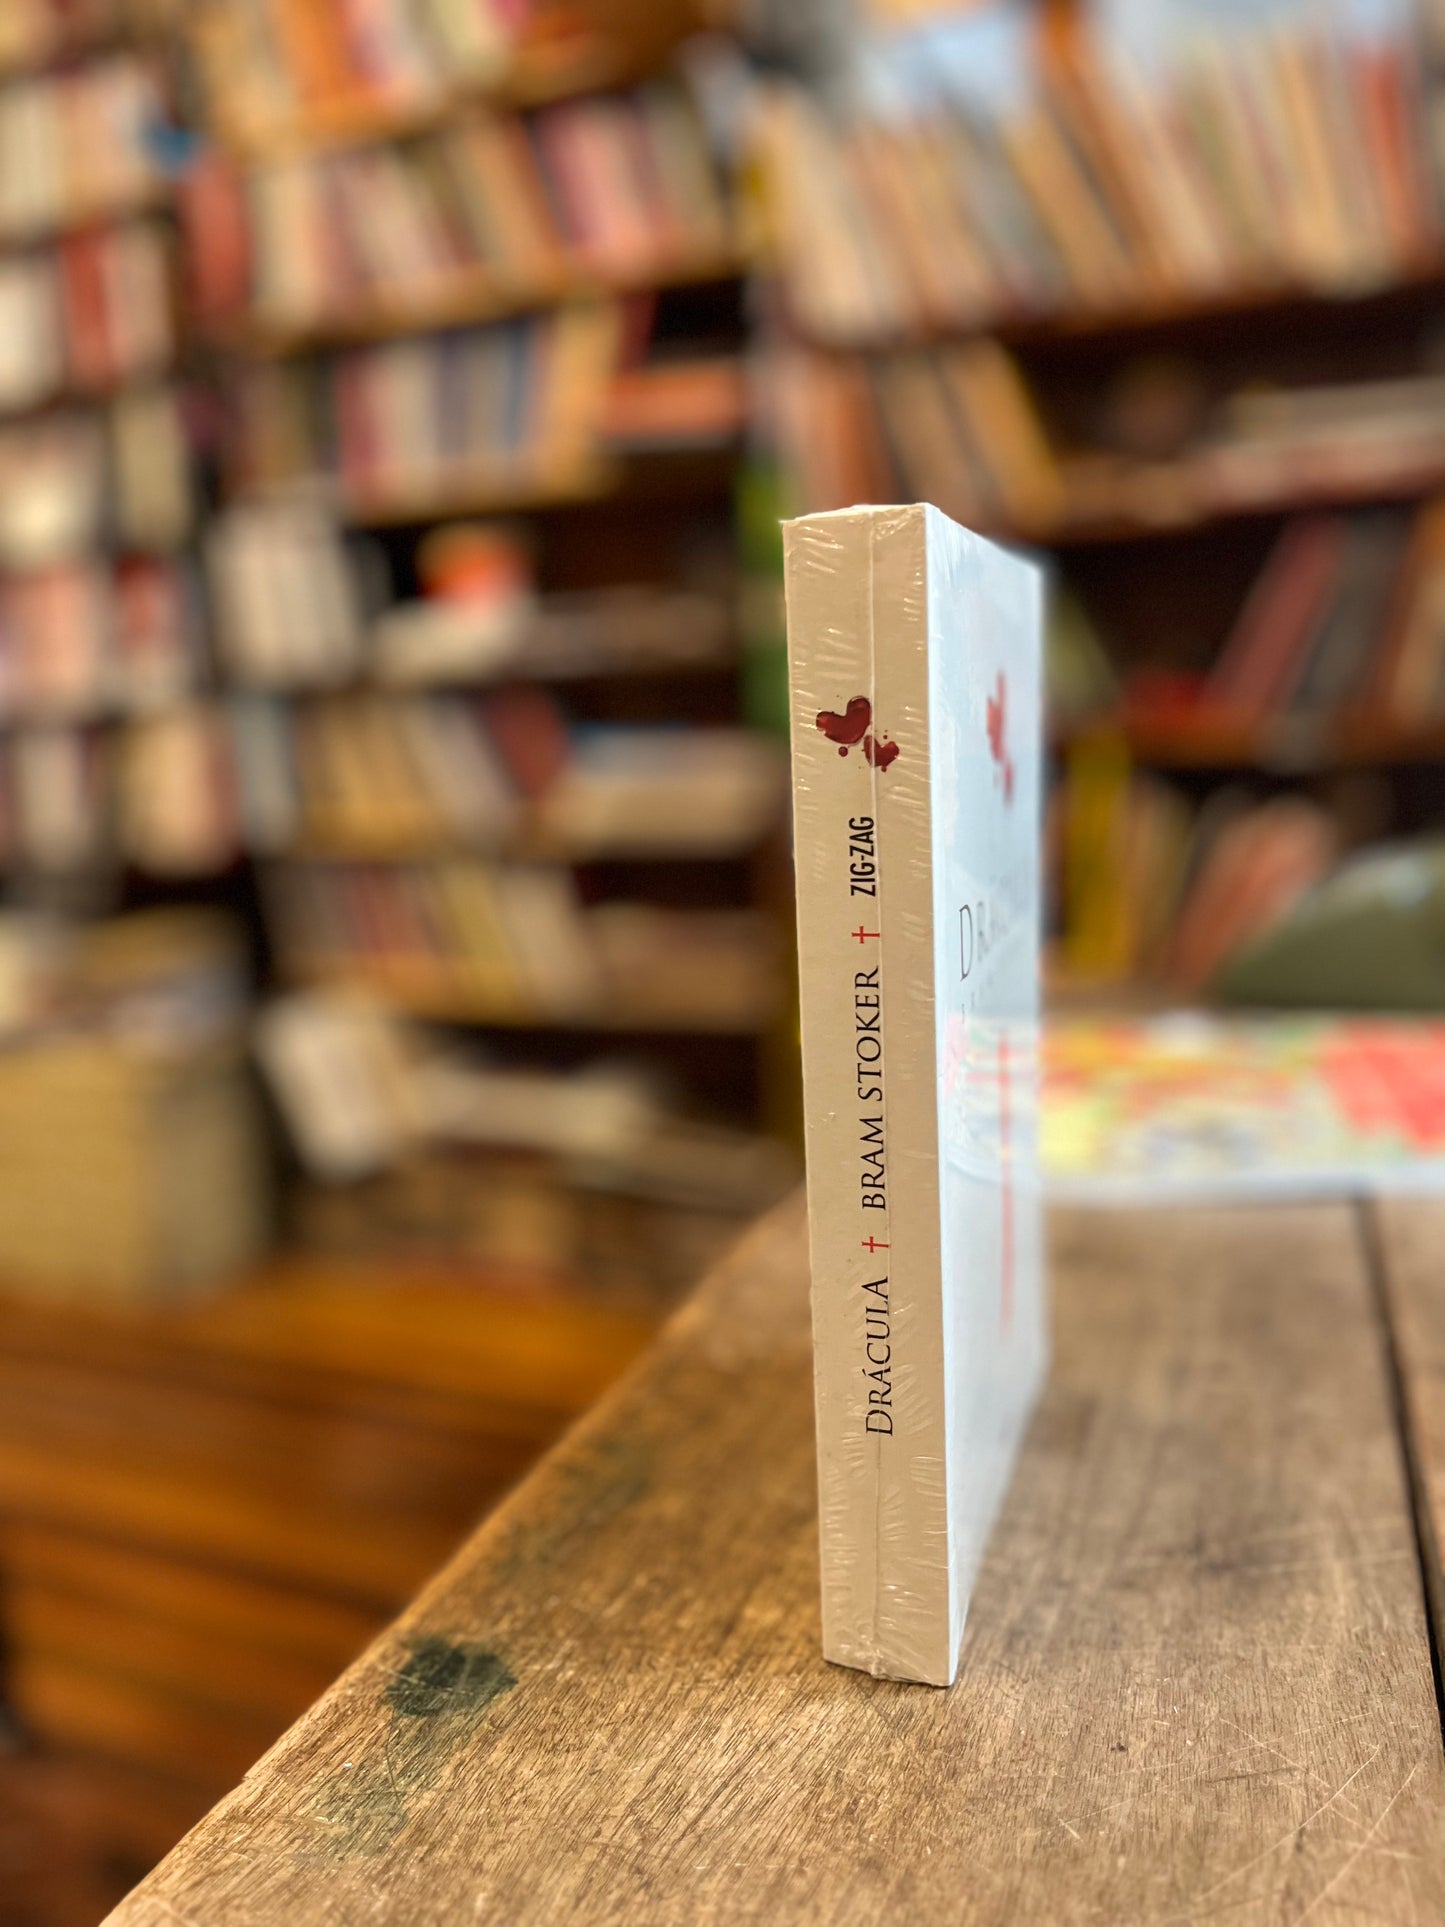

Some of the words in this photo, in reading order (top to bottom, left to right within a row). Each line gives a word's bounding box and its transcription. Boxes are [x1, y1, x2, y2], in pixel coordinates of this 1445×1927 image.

[848, 816, 877, 897] ZIG-ZAG
[854, 965, 883, 1102] STOKER
[859, 1115, 886, 1211] BRAM
[862, 1276, 893, 1437] DRÁCULA
